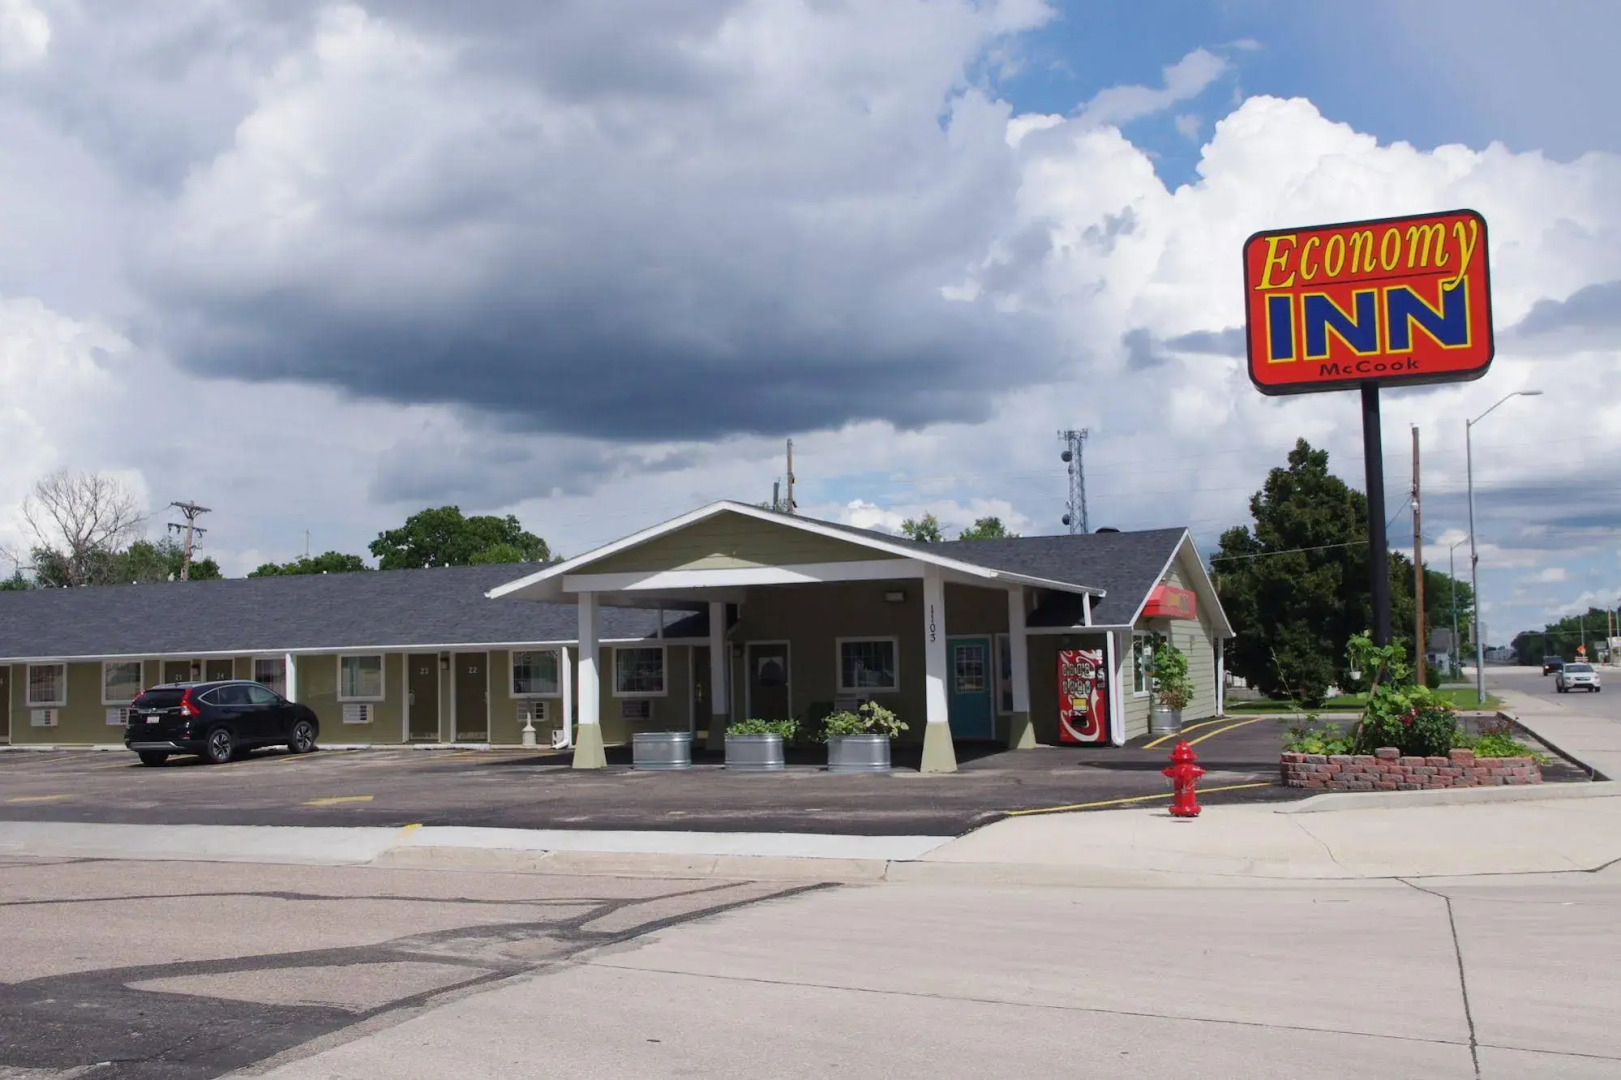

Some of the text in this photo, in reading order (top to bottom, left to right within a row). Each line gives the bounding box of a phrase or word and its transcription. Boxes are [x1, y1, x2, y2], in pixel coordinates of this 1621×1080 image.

[1254, 218, 1478, 291] Economy
[1265, 275, 1472, 363] INN
[1320, 357, 1419, 376] McCook
